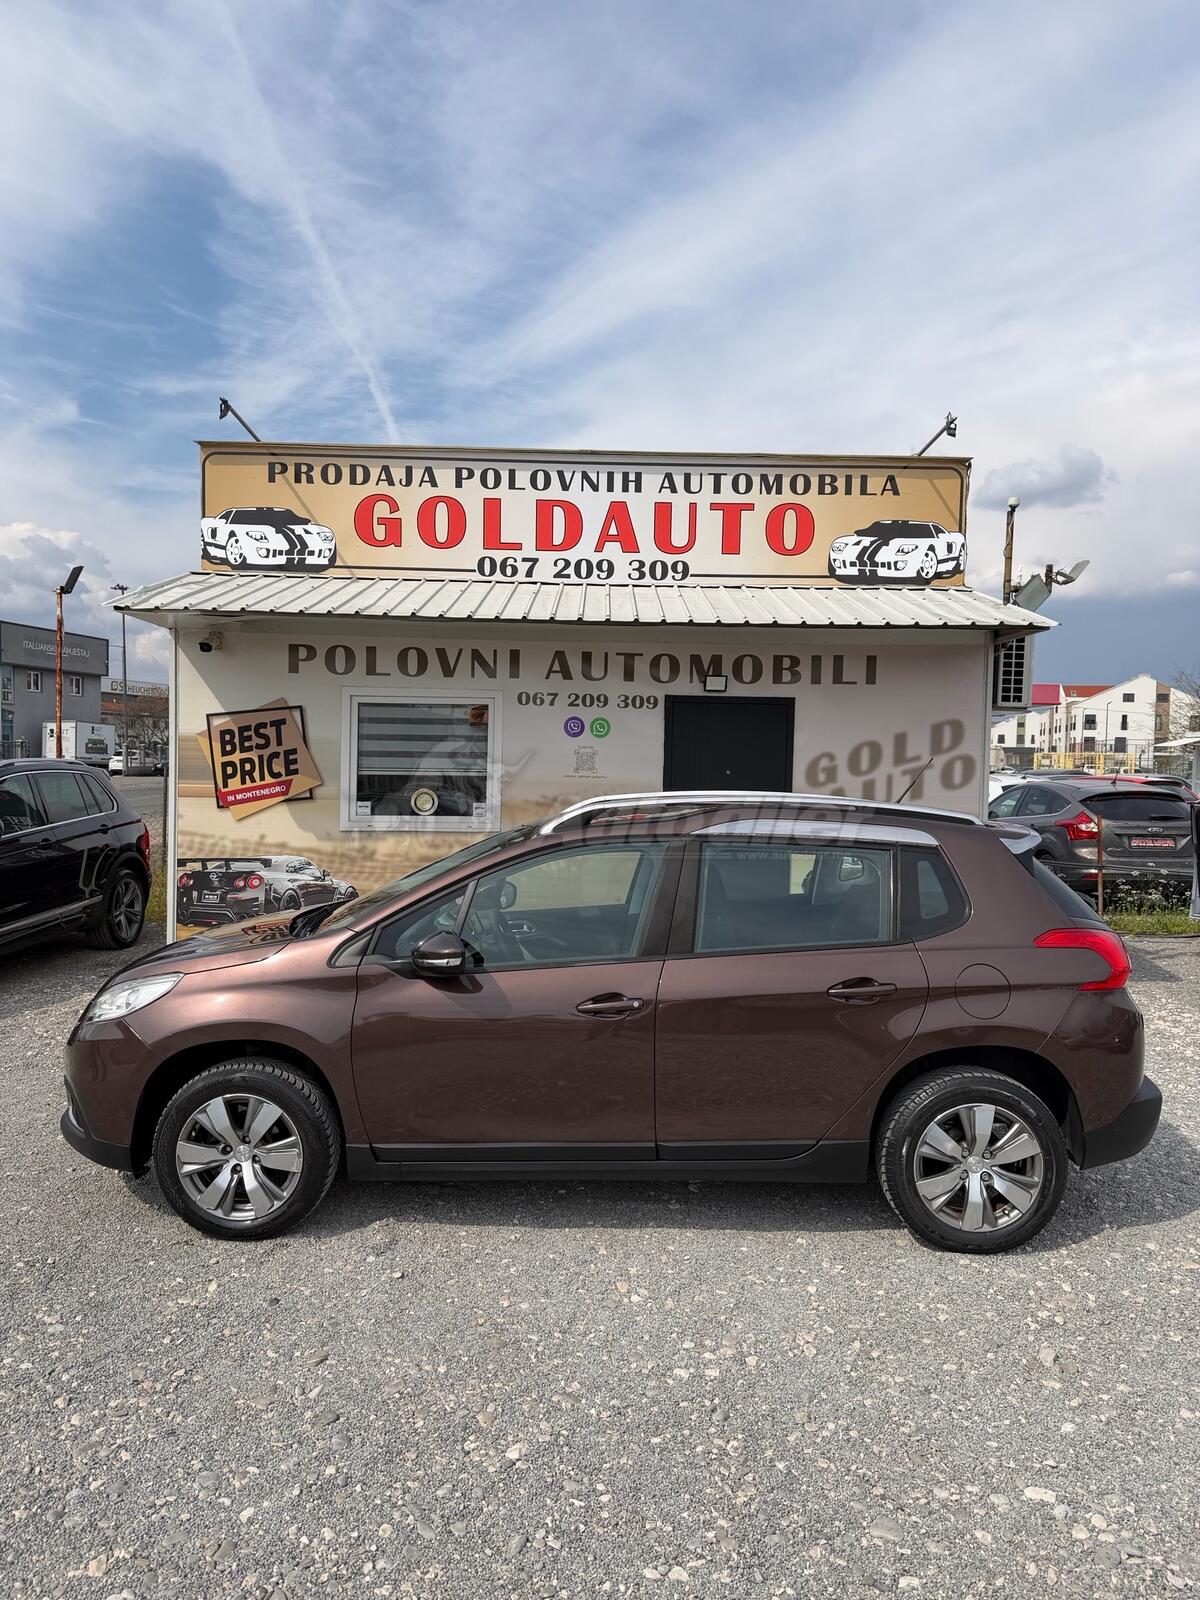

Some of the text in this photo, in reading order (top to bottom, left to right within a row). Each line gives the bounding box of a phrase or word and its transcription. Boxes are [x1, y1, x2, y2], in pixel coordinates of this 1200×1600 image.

[267, 461, 901, 497] PRODAJA POLOVNIH AUTOMOBILA
[354, 493, 815, 556] GOLDAUTO
[476, 556, 690, 582] 067 209 309
[288, 643, 877, 685] POLOVNI AUTOMOBILI
[517, 691, 659, 710] 067 209 309
[219, 717, 287, 758] BEST
[804, 718, 965, 789] GOLD
[221, 747, 300, 789] PRICE
[236, 785, 287, 801] MONTENEGRO
